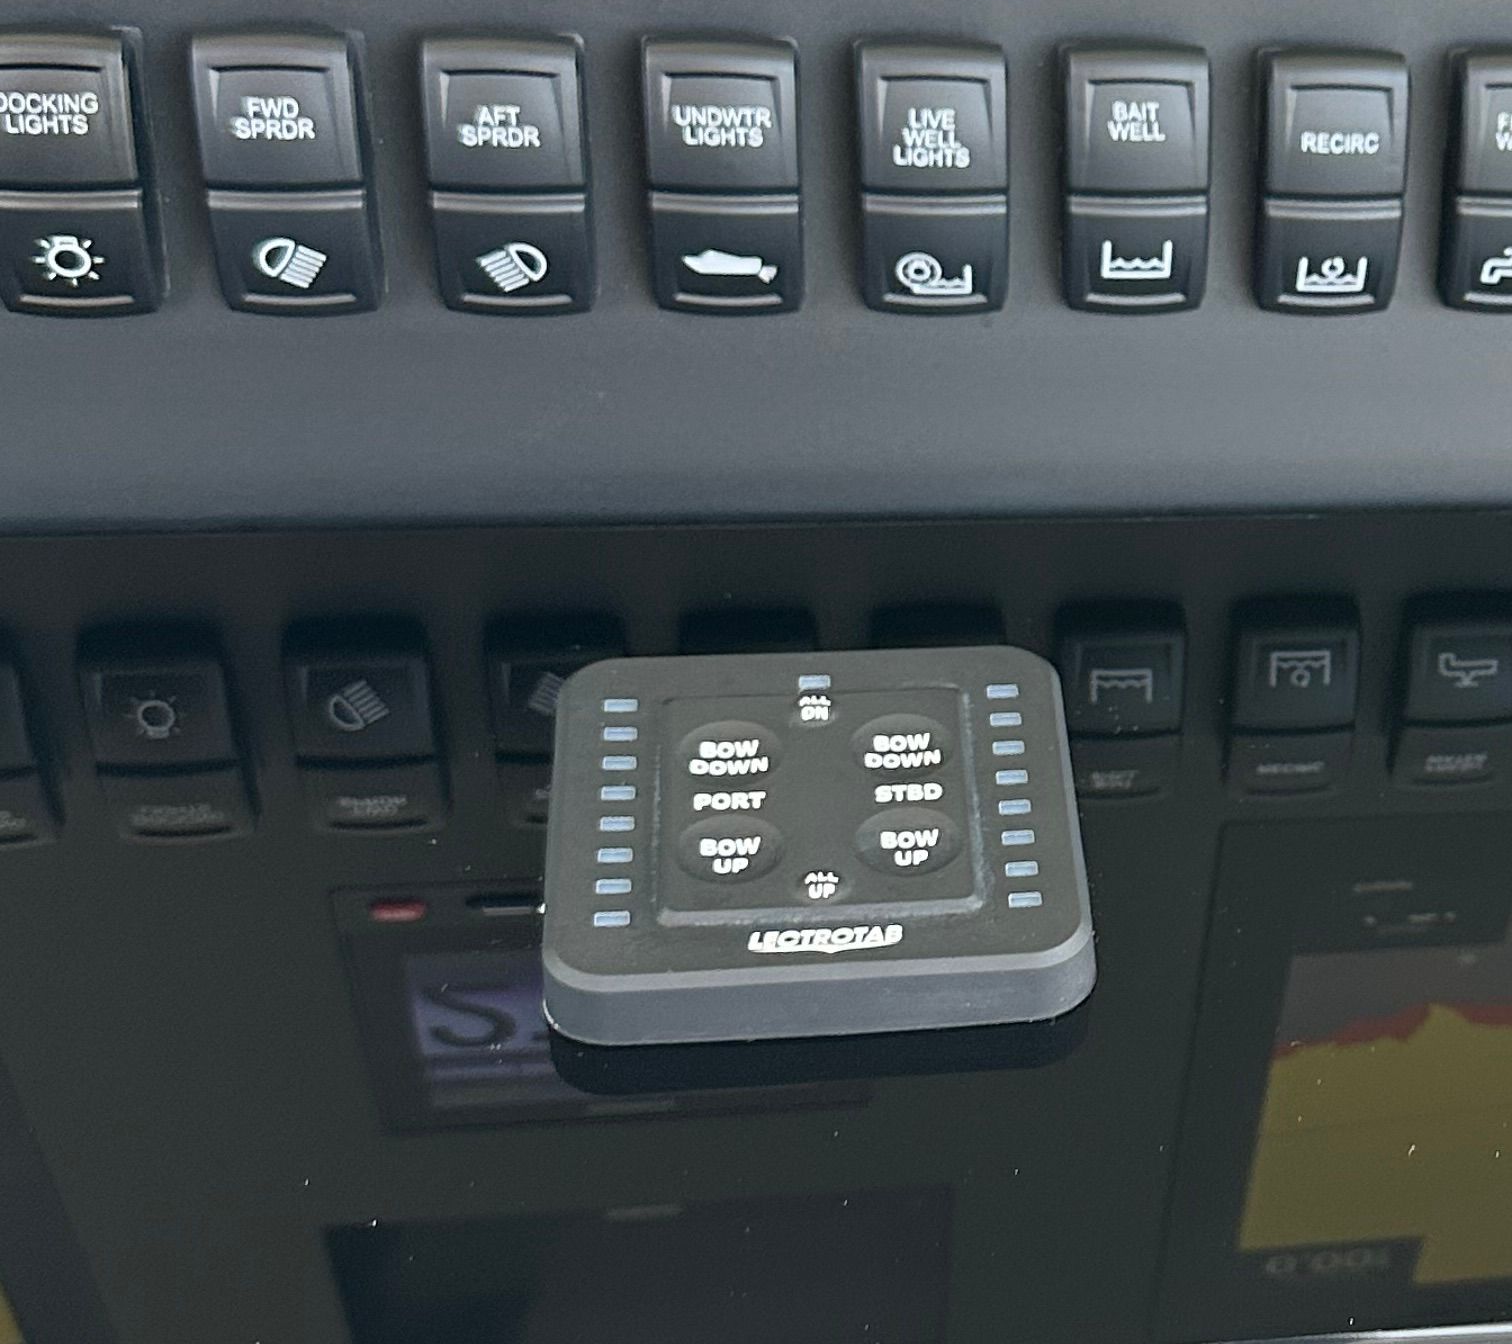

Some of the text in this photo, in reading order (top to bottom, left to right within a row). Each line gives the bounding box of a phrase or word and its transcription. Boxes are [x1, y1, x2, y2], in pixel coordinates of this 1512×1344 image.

[0, 91, 99, 115] DOCKING
[246, 95, 300, 119] FWD
[1111, 100, 1160, 122] BAIT
[5, 113, 90, 136] LIGHTS
[475, 105, 521, 127] AFT
[671, 105, 772, 127] UNDWTR
[908, 108, 956, 130] LIVE
[229, 115, 316, 141] SPRDR
[456, 124, 541, 149] SPRDR
[682, 125, 764, 148] LIGHTS
[903, 127, 961, 149] WELL
[1107, 119, 1165, 142] WELL
[1300, 130, 1380, 155] RECIRC
[893, 145, 970, 169] LIGHTS
[799, 695, 831, 708] ALL
[699, 739, 759, 759] BOW
[872, 733, 930, 753] BOW
[689, 757, 769, 777] DOWN
[864, 749, 941, 769] DOWN
[693, 790, 766, 811] PORT
[874, 782, 943, 803] STBD
[700, 837, 761, 858] BOW
[879, 828, 939, 850] BOW
[712, 856, 749, 875] UP
[894, 847, 930, 867] UP
[804, 871, 838, 886] ALL
[808, 882, 837, 899] UP
[747, 925, 903, 954] LECTROTAB
